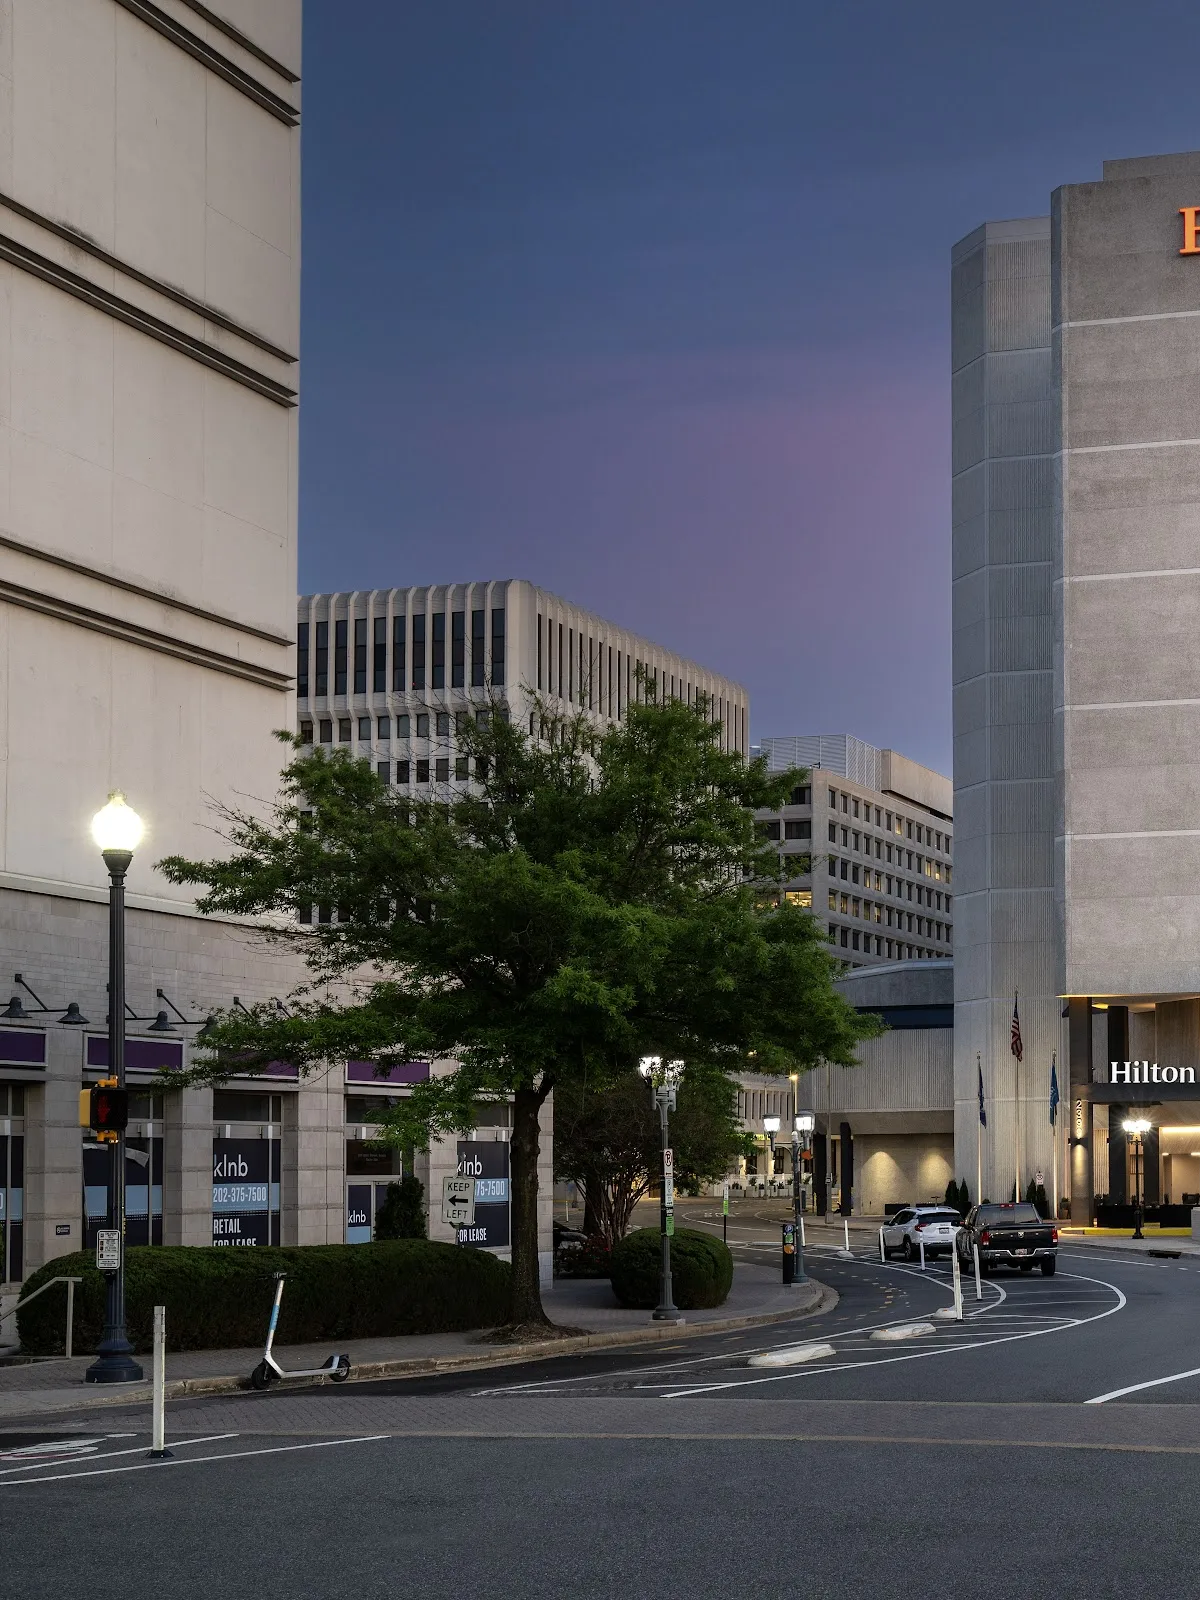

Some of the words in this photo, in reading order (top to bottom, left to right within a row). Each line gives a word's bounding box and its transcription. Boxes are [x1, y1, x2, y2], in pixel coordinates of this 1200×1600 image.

[1110, 1061, 1195, 1083] Hilton
[213, 1153, 248, 1177] klnb
[447, 1182, 470, 1191] KEEP
[475, 1181, 505, 1196] 75-7500
[213, 1187, 267, 1202] 202-375-7500
[348, 1210, 366, 1223] klnb
[446, 1210, 468, 1219] LEFT
[213, 1218, 241, 1234] RETAIL
[468, 1228, 487, 1241] LEASE
